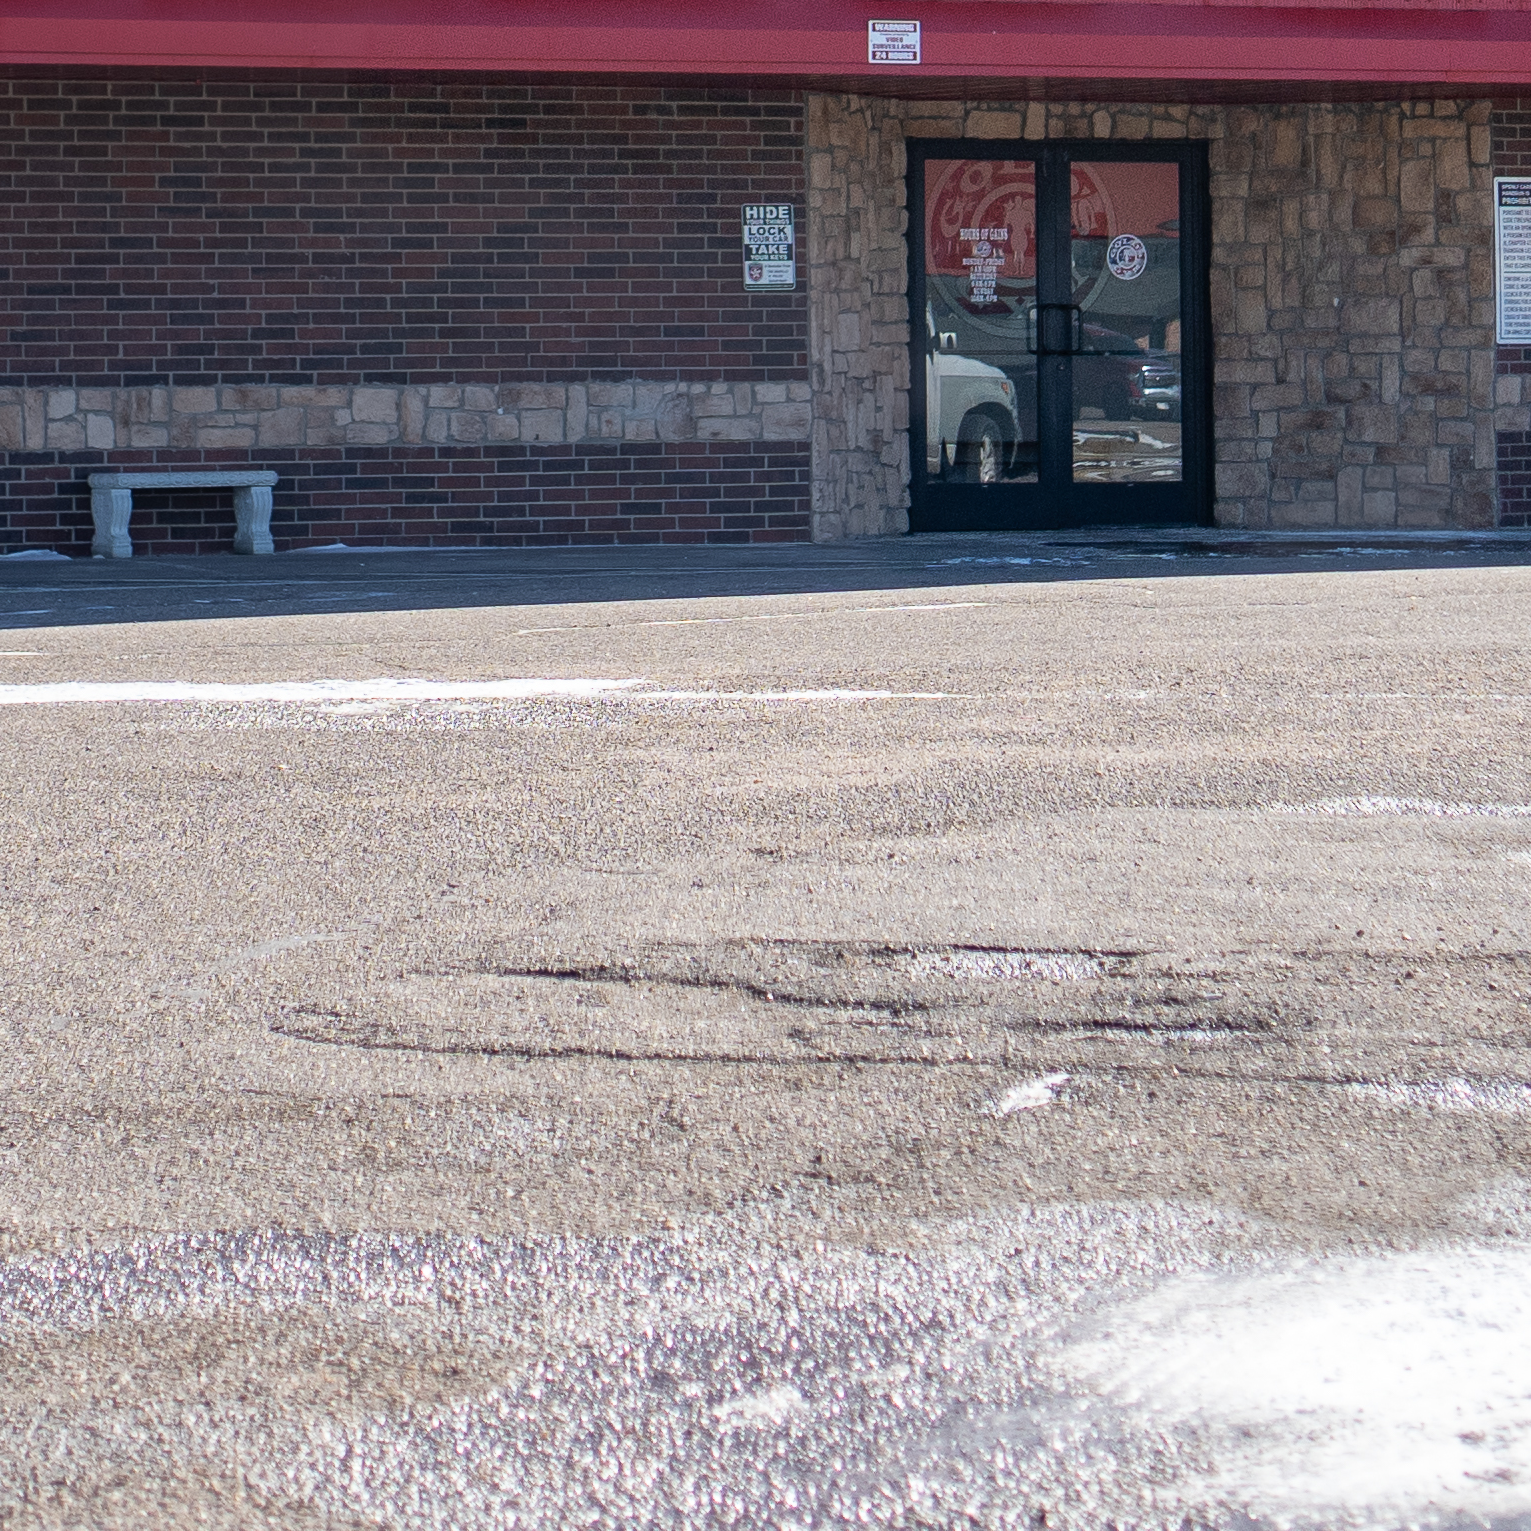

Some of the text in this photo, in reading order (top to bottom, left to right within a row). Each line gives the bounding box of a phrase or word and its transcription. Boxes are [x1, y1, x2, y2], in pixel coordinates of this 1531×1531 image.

[746, 206, 789, 219] HIDE
[748, 227, 787, 236] LOCK
[749, 244, 788, 255] TAKE
